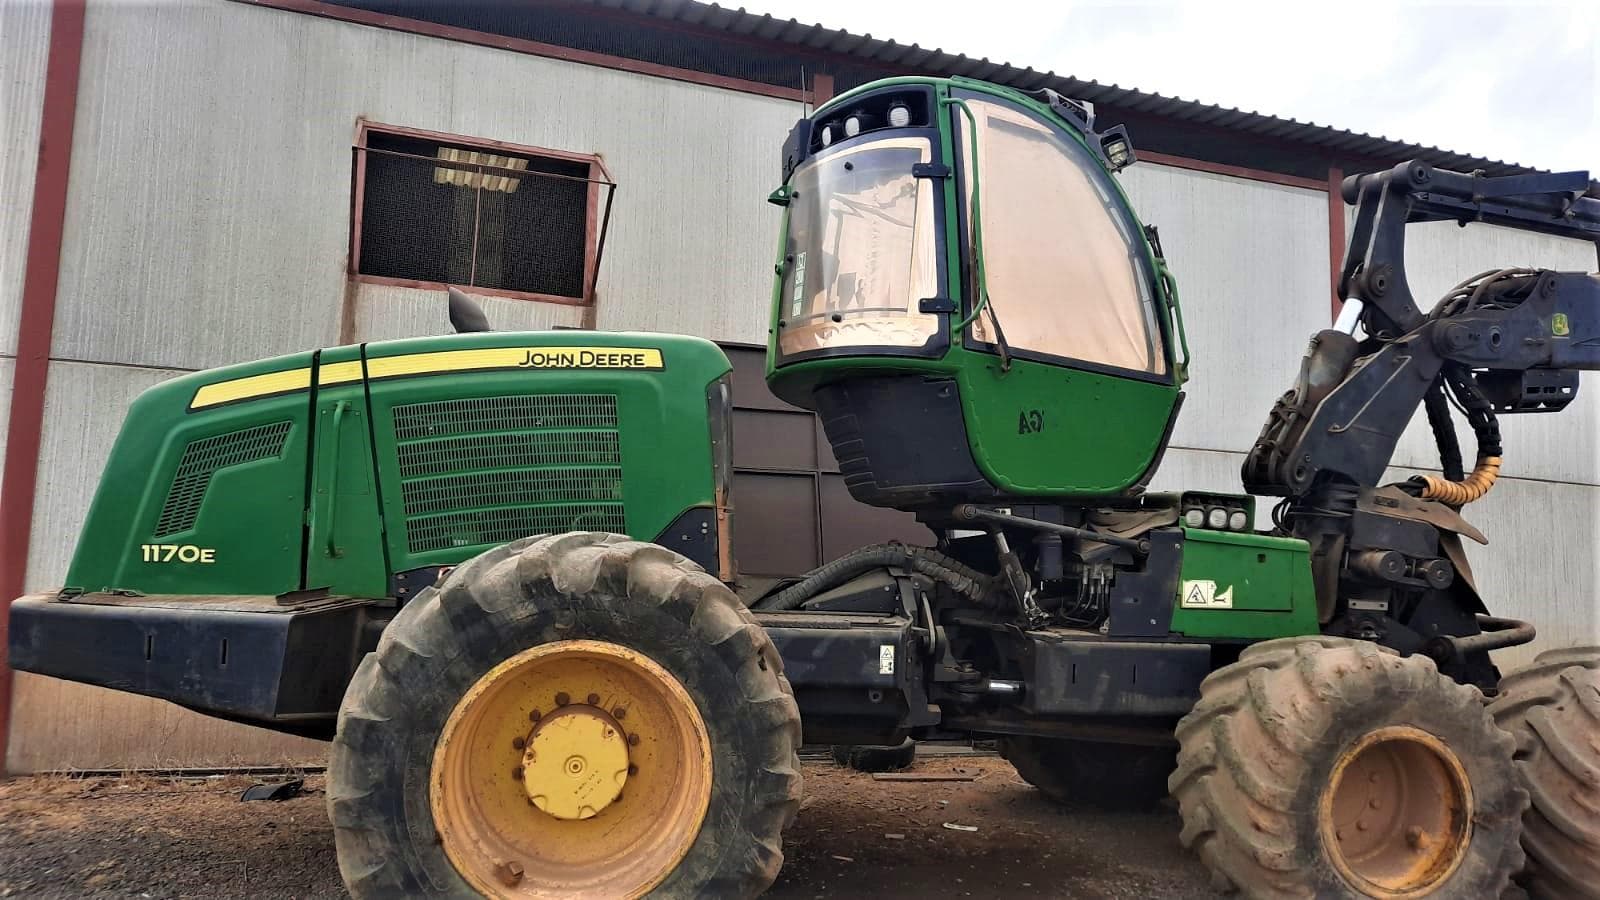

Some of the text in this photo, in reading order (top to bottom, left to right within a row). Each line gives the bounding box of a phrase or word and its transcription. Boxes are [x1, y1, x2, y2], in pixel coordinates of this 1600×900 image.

[519, 350, 645, 366] JOHN DEERE
[141, 544, 216, 563] 1170E
